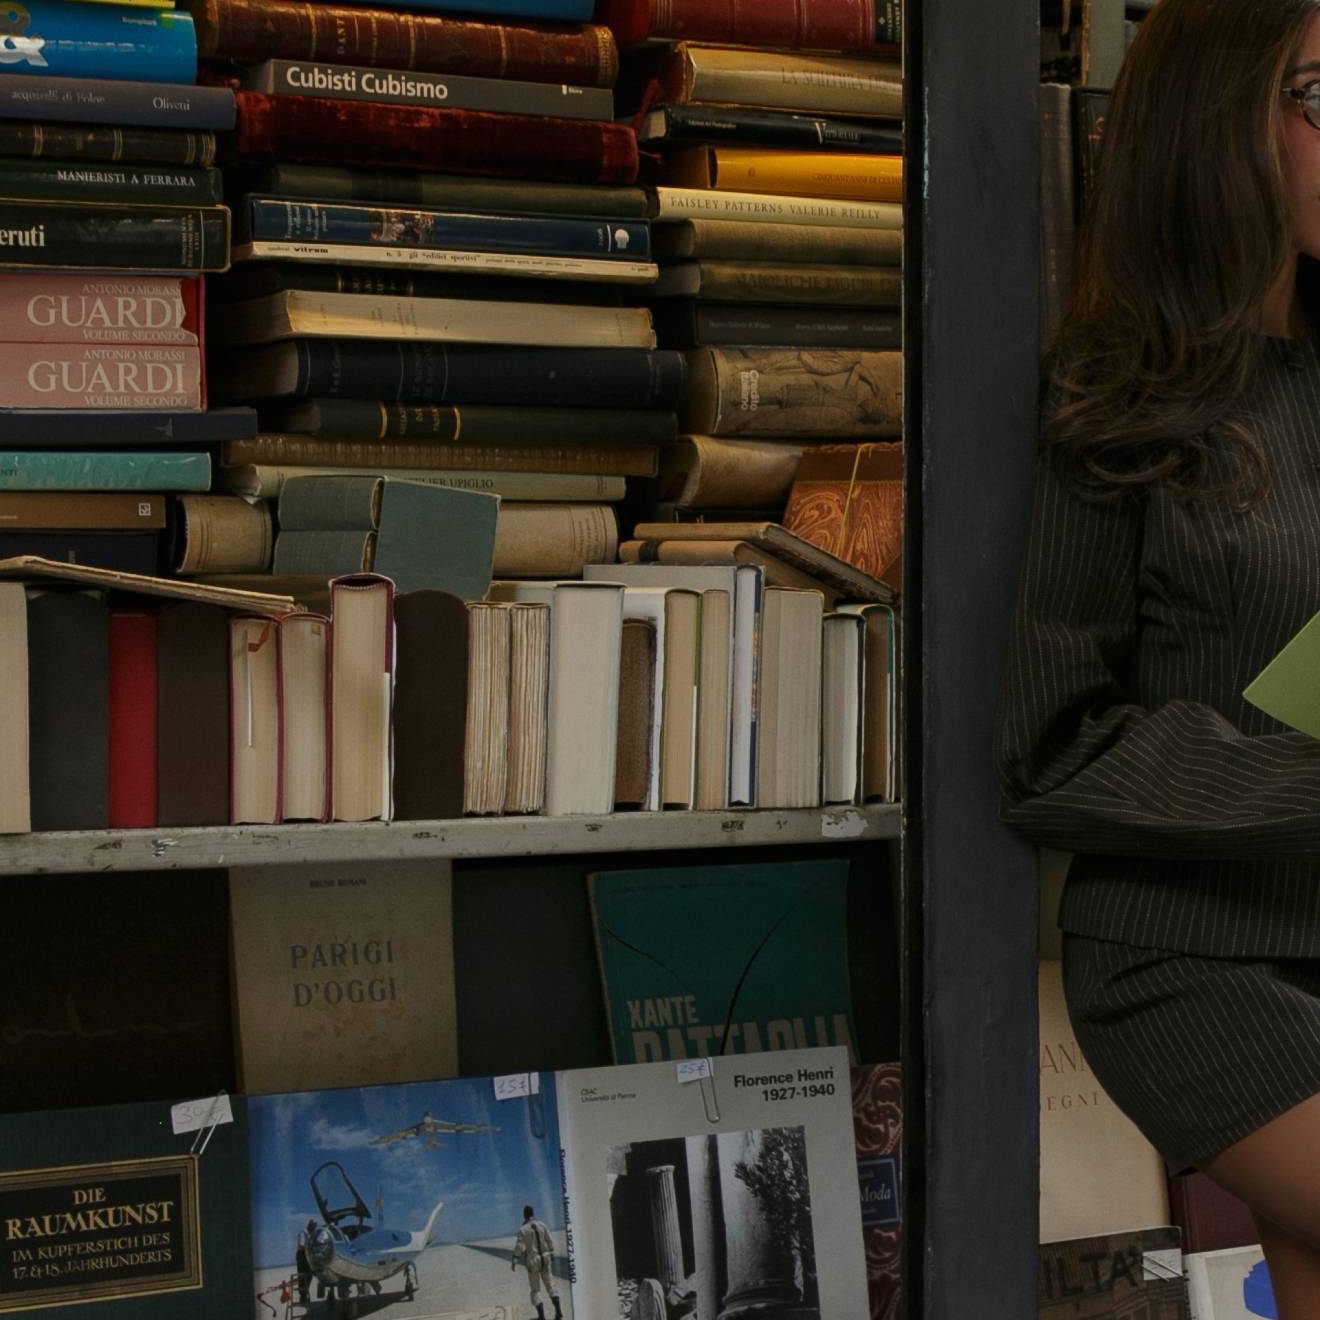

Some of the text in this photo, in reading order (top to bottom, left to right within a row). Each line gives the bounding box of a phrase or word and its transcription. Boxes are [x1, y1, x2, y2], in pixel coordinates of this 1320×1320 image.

[286, 67, 448, 100] Cubisti Cubismo
[57, 170, 196, 187] MANIERISTI A FERRARA
[724, 200, 783, 215] PATTERNS
[790, 205, 837, 218] VALERIE
[841, 209, 881, 220] REILLY
[0, 225, 45, 247] eruti
[294, 246, 328, 254] vitrum
[82, 284, 181, 296] ANTONIO MORASS
[27, 294, 183, 329] GUARDI
[82, 330, 185, 342] VOLUME SECONDO
[84, 349, 185, 361] ANTONIO MORASSI
[28, 361, 186, 394] GUARDI
[84, 395, 187, 407] VOLUME SECONDO
[749, 369, 759, 411] Credito
[291, 939, 396, 970] PARIGI
[293, 978, 398, 1009] D'OGGI
[734, 1066, 834, 1089] Florence Henri
[762, 1083, 835, 1102] 1927-1940
[73, 1187, 107, 1206] DIE
[5, 1201, 174, 1241] RAUMKUNST
[12, 1232, 171, 1264] IM KUPFERSTICH DES
[12, 1266, 28, 1279] 17.
[45, 1262, 63, 1277] 18.
[64, 1249, 172, 1274] JAHRHUNDERTS
